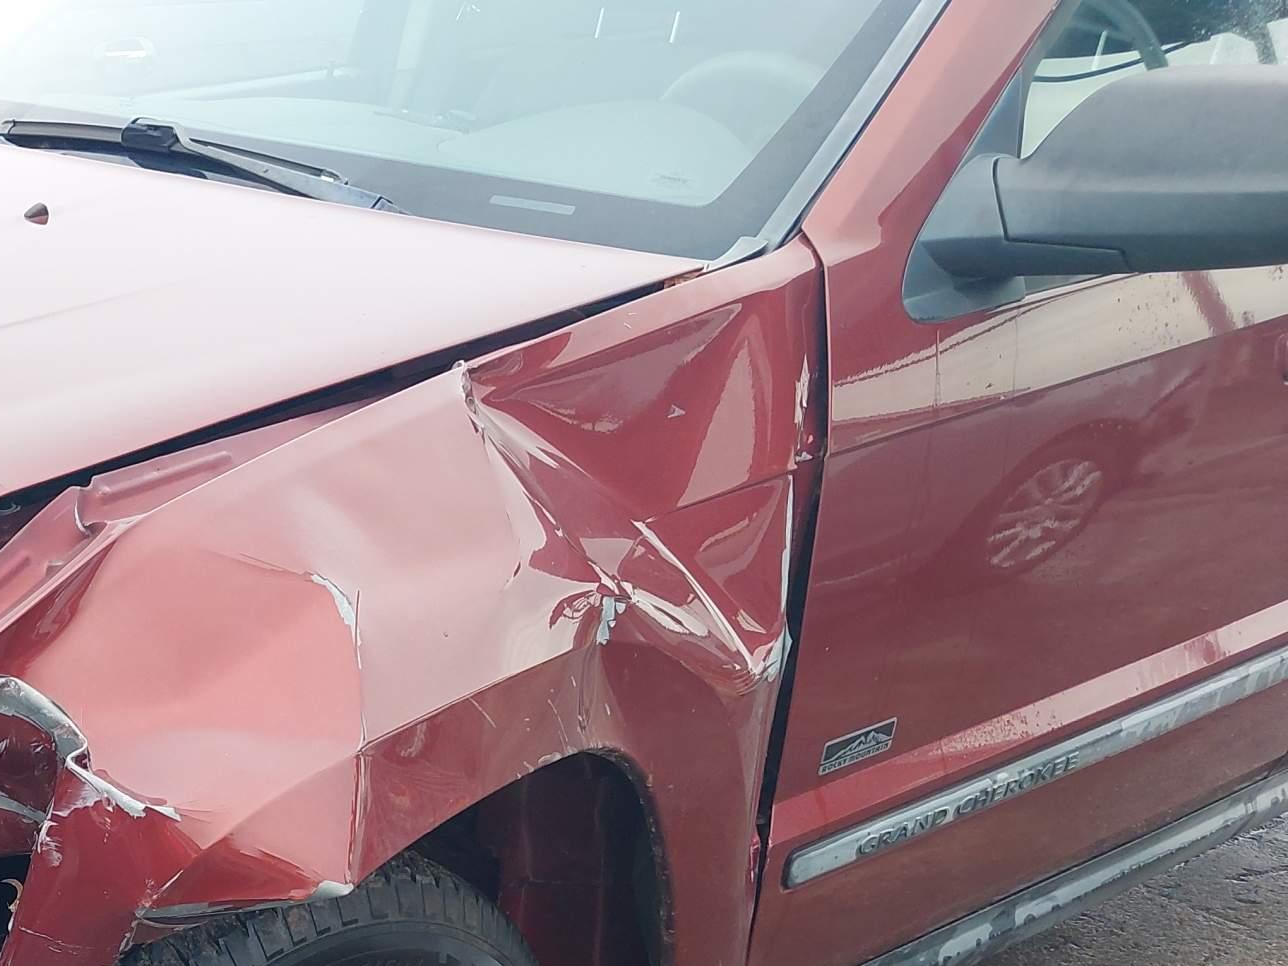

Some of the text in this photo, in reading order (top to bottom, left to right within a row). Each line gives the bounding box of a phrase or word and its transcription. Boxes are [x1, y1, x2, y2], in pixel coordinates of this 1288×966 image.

[821, 743, 889, 774] ROCKY MOUNTAIN
[857, 751, 1079, 855] GRAND CHEROKEE
